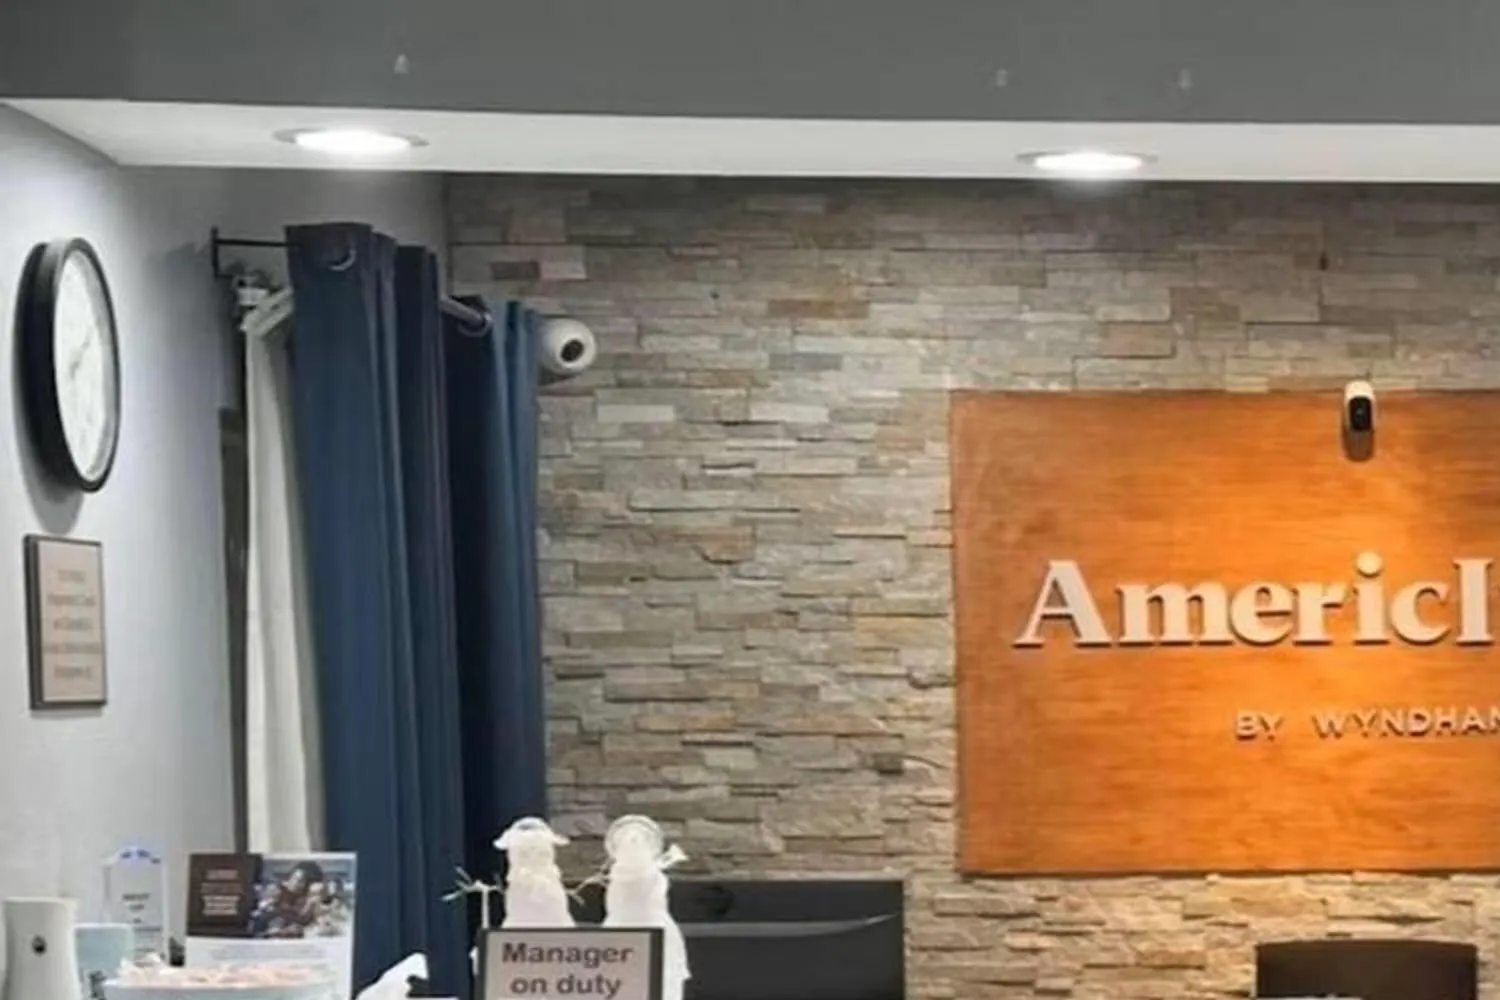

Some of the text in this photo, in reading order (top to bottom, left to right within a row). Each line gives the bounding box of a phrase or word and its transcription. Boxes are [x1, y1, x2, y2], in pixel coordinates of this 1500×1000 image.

[1236, 711, 1285, 740] BY
[502, 942, 634, 968] Manager
[510, 974, 622, 999] on duty
